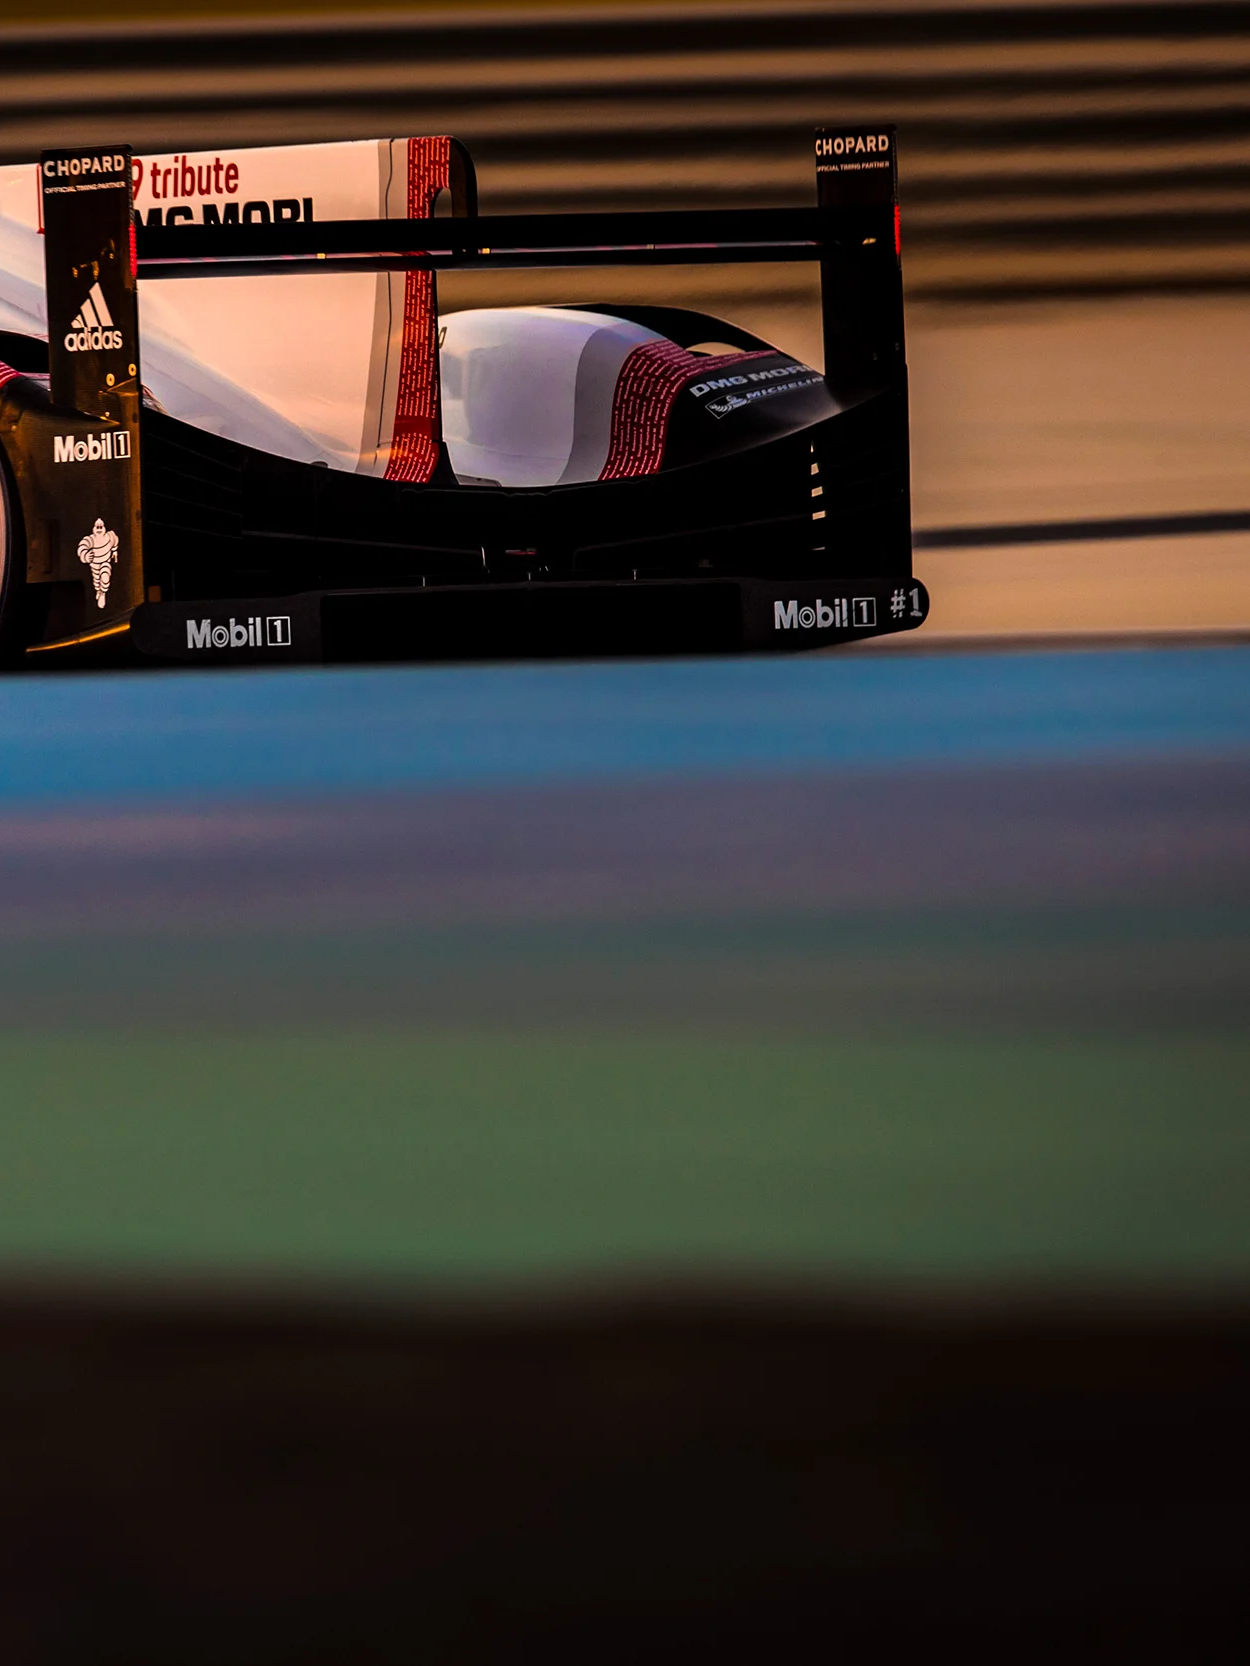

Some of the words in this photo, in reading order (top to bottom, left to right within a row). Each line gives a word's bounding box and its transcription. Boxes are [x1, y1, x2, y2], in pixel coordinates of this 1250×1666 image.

[815, 134, 890, 156] CHOPARD
[43, 154, 125, 177] CHOPARD
[150, 155, 239, 199] tribute
[65, 327, 123, 352] adidas
[690, 375, 748, 397] DMG
[54, 432, 112, 463] Mobil
[774, 598, 849, 629] Mobil
[890, 587, 923, 618] #1
[186, 617, 263, 649] Mobil
